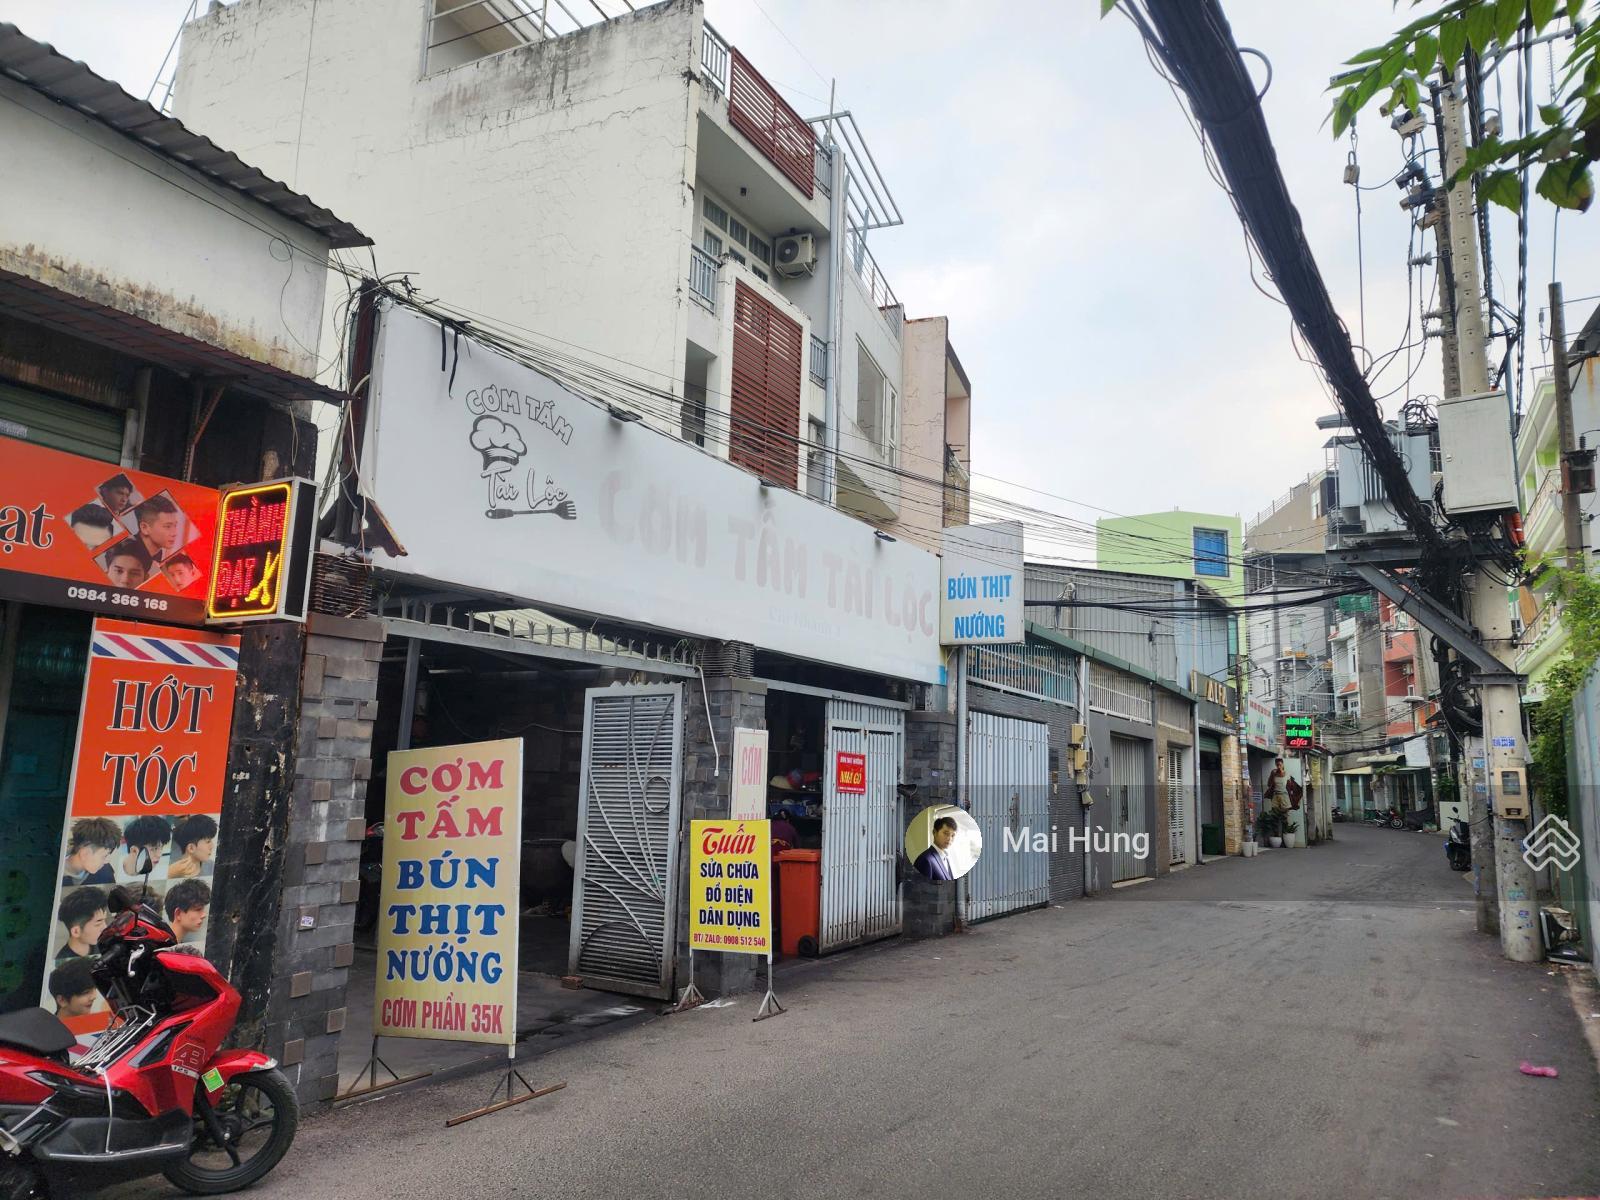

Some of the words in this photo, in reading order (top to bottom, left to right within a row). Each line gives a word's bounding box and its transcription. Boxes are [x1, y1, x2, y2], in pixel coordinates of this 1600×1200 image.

[465, 383, 521, 416] CƠM
[526, 467, 568, 510] Lộc
[222, 495, 286, 547] THÀNH
[67, 585, 107, 603] 0984
[111, 592, 139, 608] 366
[143, 597, 168, 611] 168
[884, 570, 934, 644] LỘC
[947, 571, 977, 602] BÚN
[981, 573, 1013, 604] THỊT
[953, 610, 1006, 640] NƯỚNG
[106, 672, 214, 735] HỚT
[101, 746, 198, 807] TÓC
[399, 757, 505, 796] CƠM
[396, 794, 504, 841] TẤM
[701, 823, 757, 856] Tuấn
[396, 850, 500, 890] BÚN
[700, 858, 724, 879] SỬA
[726, 861, 758, 879] CHỮA
[725, 885, 753, 907] ĐIỆN
[388, 903, 506, 944] THỊT
[699, 906, 724, 927] DÂN
[727, 910, 759, 930] DỤNG
[740, 936, 752, 946] 512
[753, 937, 766, 947] 540
[385, 941, 503, 985] NƯỚNG
[381, 996, 417, 1029] CƠM
[421, 990, 467, 1033] PHẦN
[470, 1003, 504, 1035] 35K
